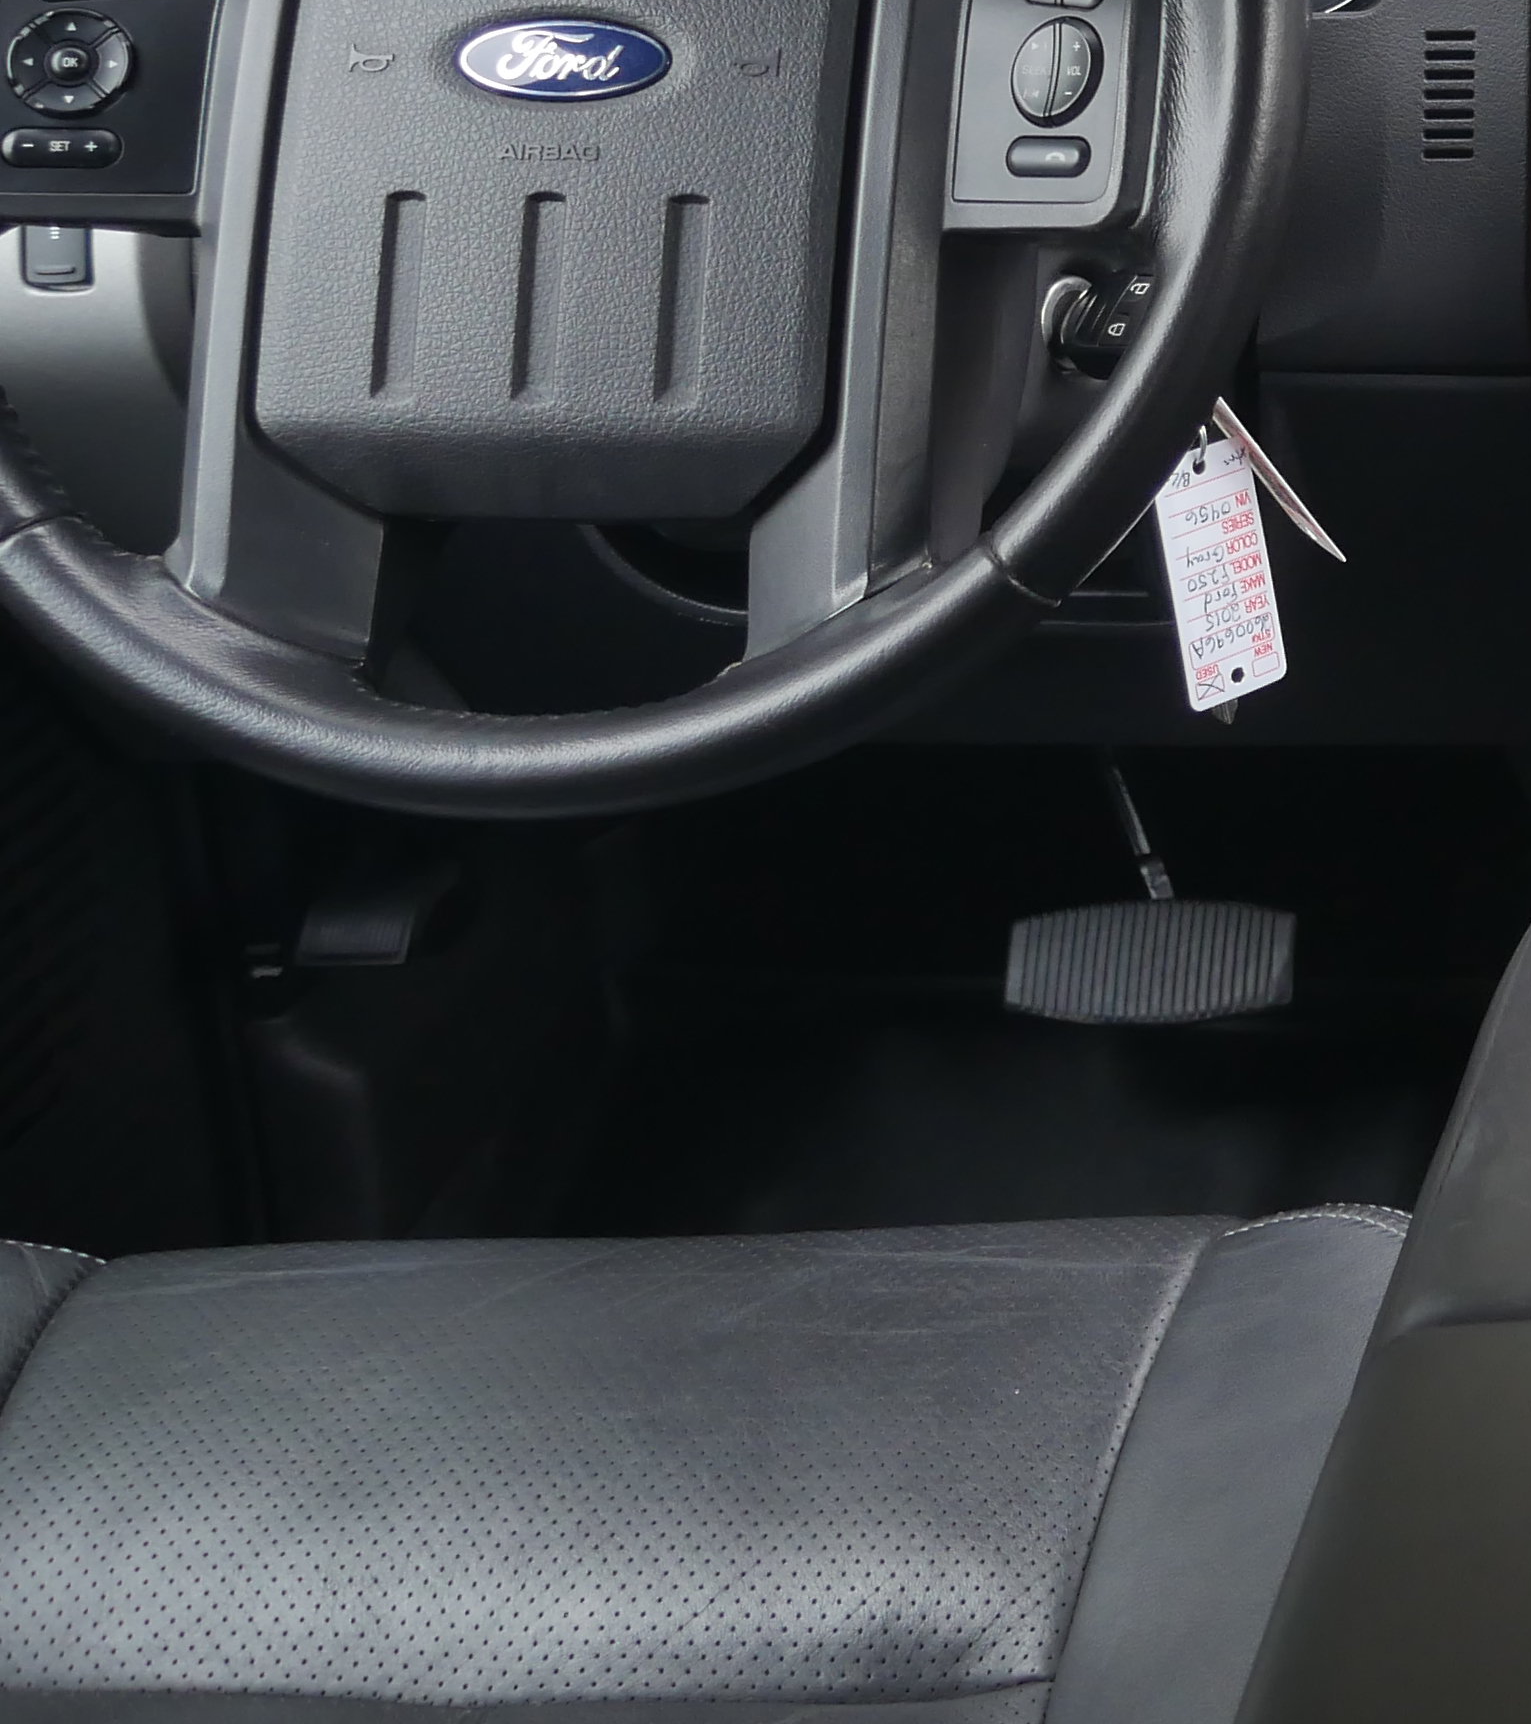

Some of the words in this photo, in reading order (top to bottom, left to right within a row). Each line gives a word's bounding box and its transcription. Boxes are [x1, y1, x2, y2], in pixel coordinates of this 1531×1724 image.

[63, 57, 78, 68] OK
[496, 29, 622, 82] Ford
[50, 141, 70, 152] SET
[500, 142, 600, 161] AIRBAG
[1235, 491, 1252, 508] VIN
[1221, 512, 1254, 534] SERIES
[1226, 533, 1258, 554] COLOR
[1187, 547, 1224, 568] Gray
[1230, 553, 1262, 574] MODEL
[1188, 564, 1230, 592] F250
[1240, 573, 1265, 594] MAKE
[1244, 595, 1270, 613] YEAR
[1206, 603, 1241, 632] 2015
[1254, 642, 1273, 656] NEW
[1196, 664, 1218, 680] USED
